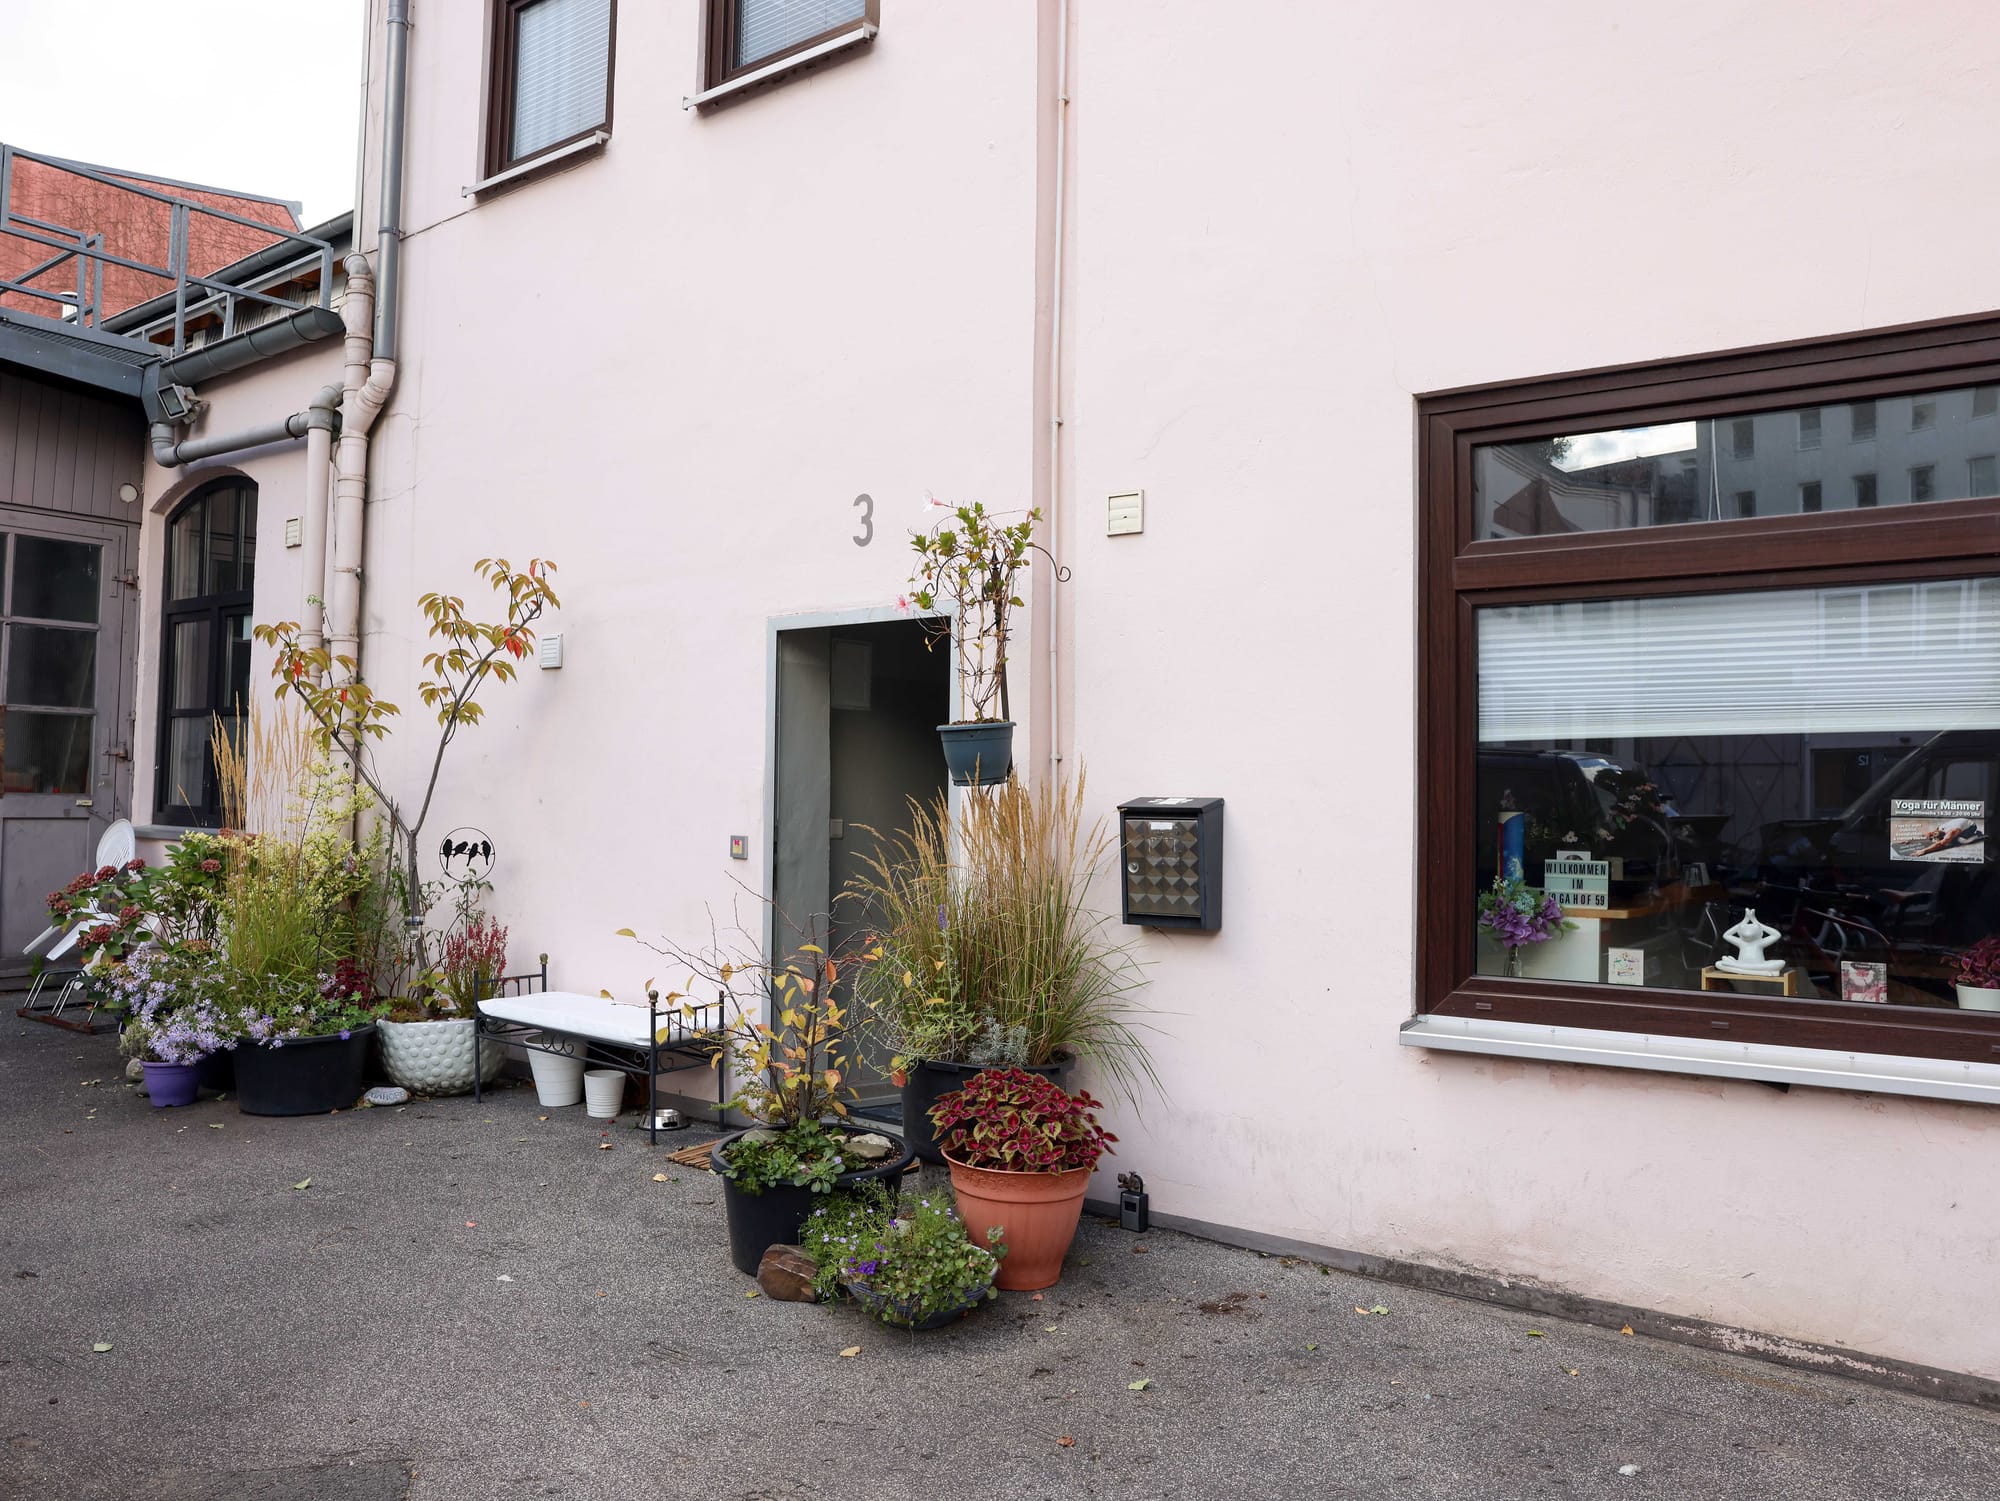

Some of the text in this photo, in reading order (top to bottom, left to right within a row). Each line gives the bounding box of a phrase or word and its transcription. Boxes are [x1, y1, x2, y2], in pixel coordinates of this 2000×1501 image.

[853, 493, 874, 548] 3
[1895, 800, 1981, 811] Yoga für Männer
[1546, 863, 1606, 875] WILLKOMMEN
[1572, 879, 1584, 889] IM
[1548, 892, 1605, 906] OGAHOF 59
